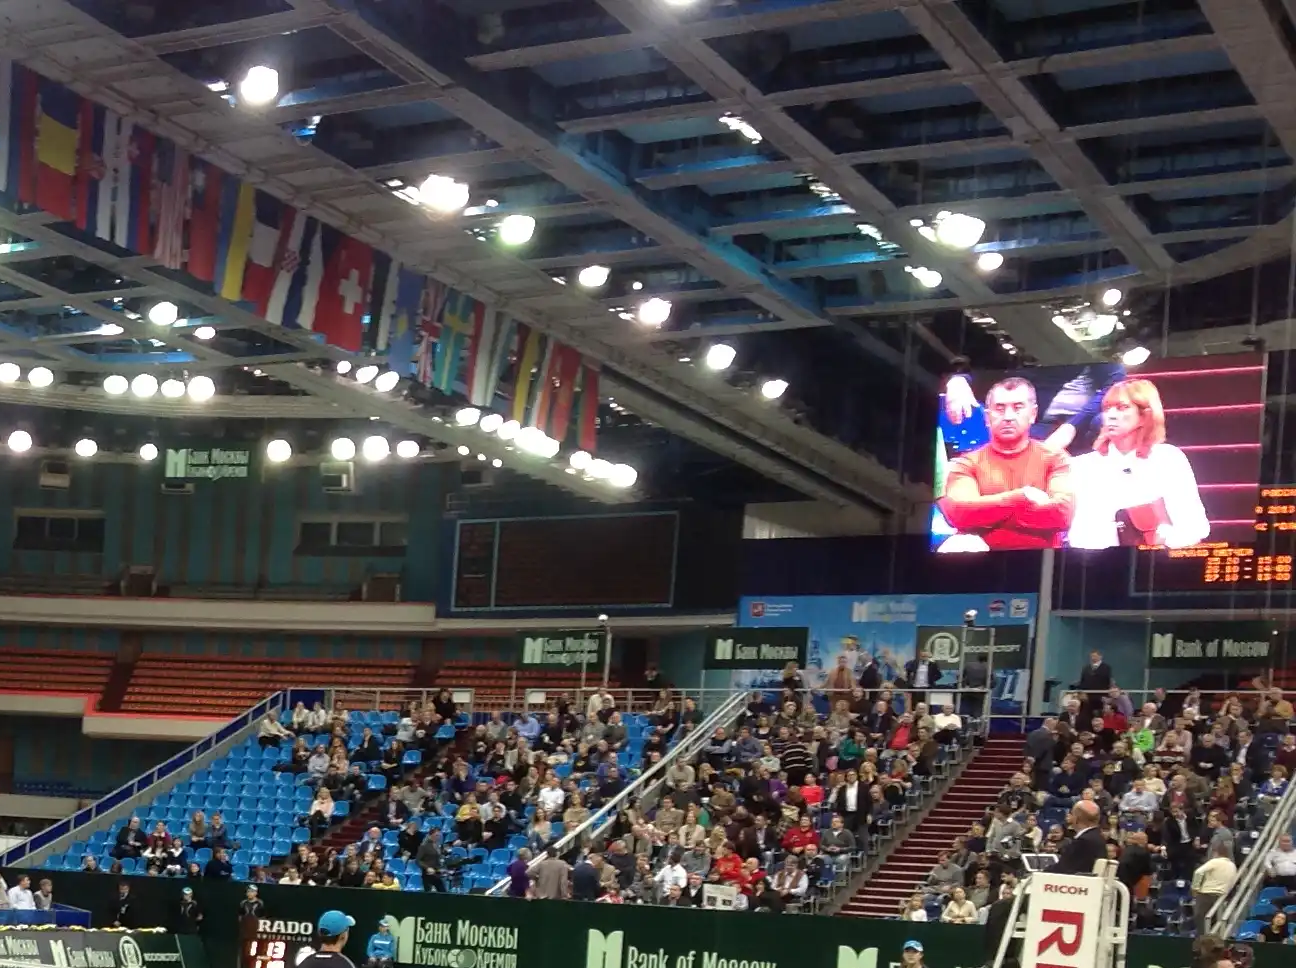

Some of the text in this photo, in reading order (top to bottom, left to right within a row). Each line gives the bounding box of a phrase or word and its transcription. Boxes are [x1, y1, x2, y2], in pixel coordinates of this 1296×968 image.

[1044, 883, 1089, 896] RICOH
[257, 919, 313, 935] RADO
[415, 916, 519, 950] Банк Москвы
